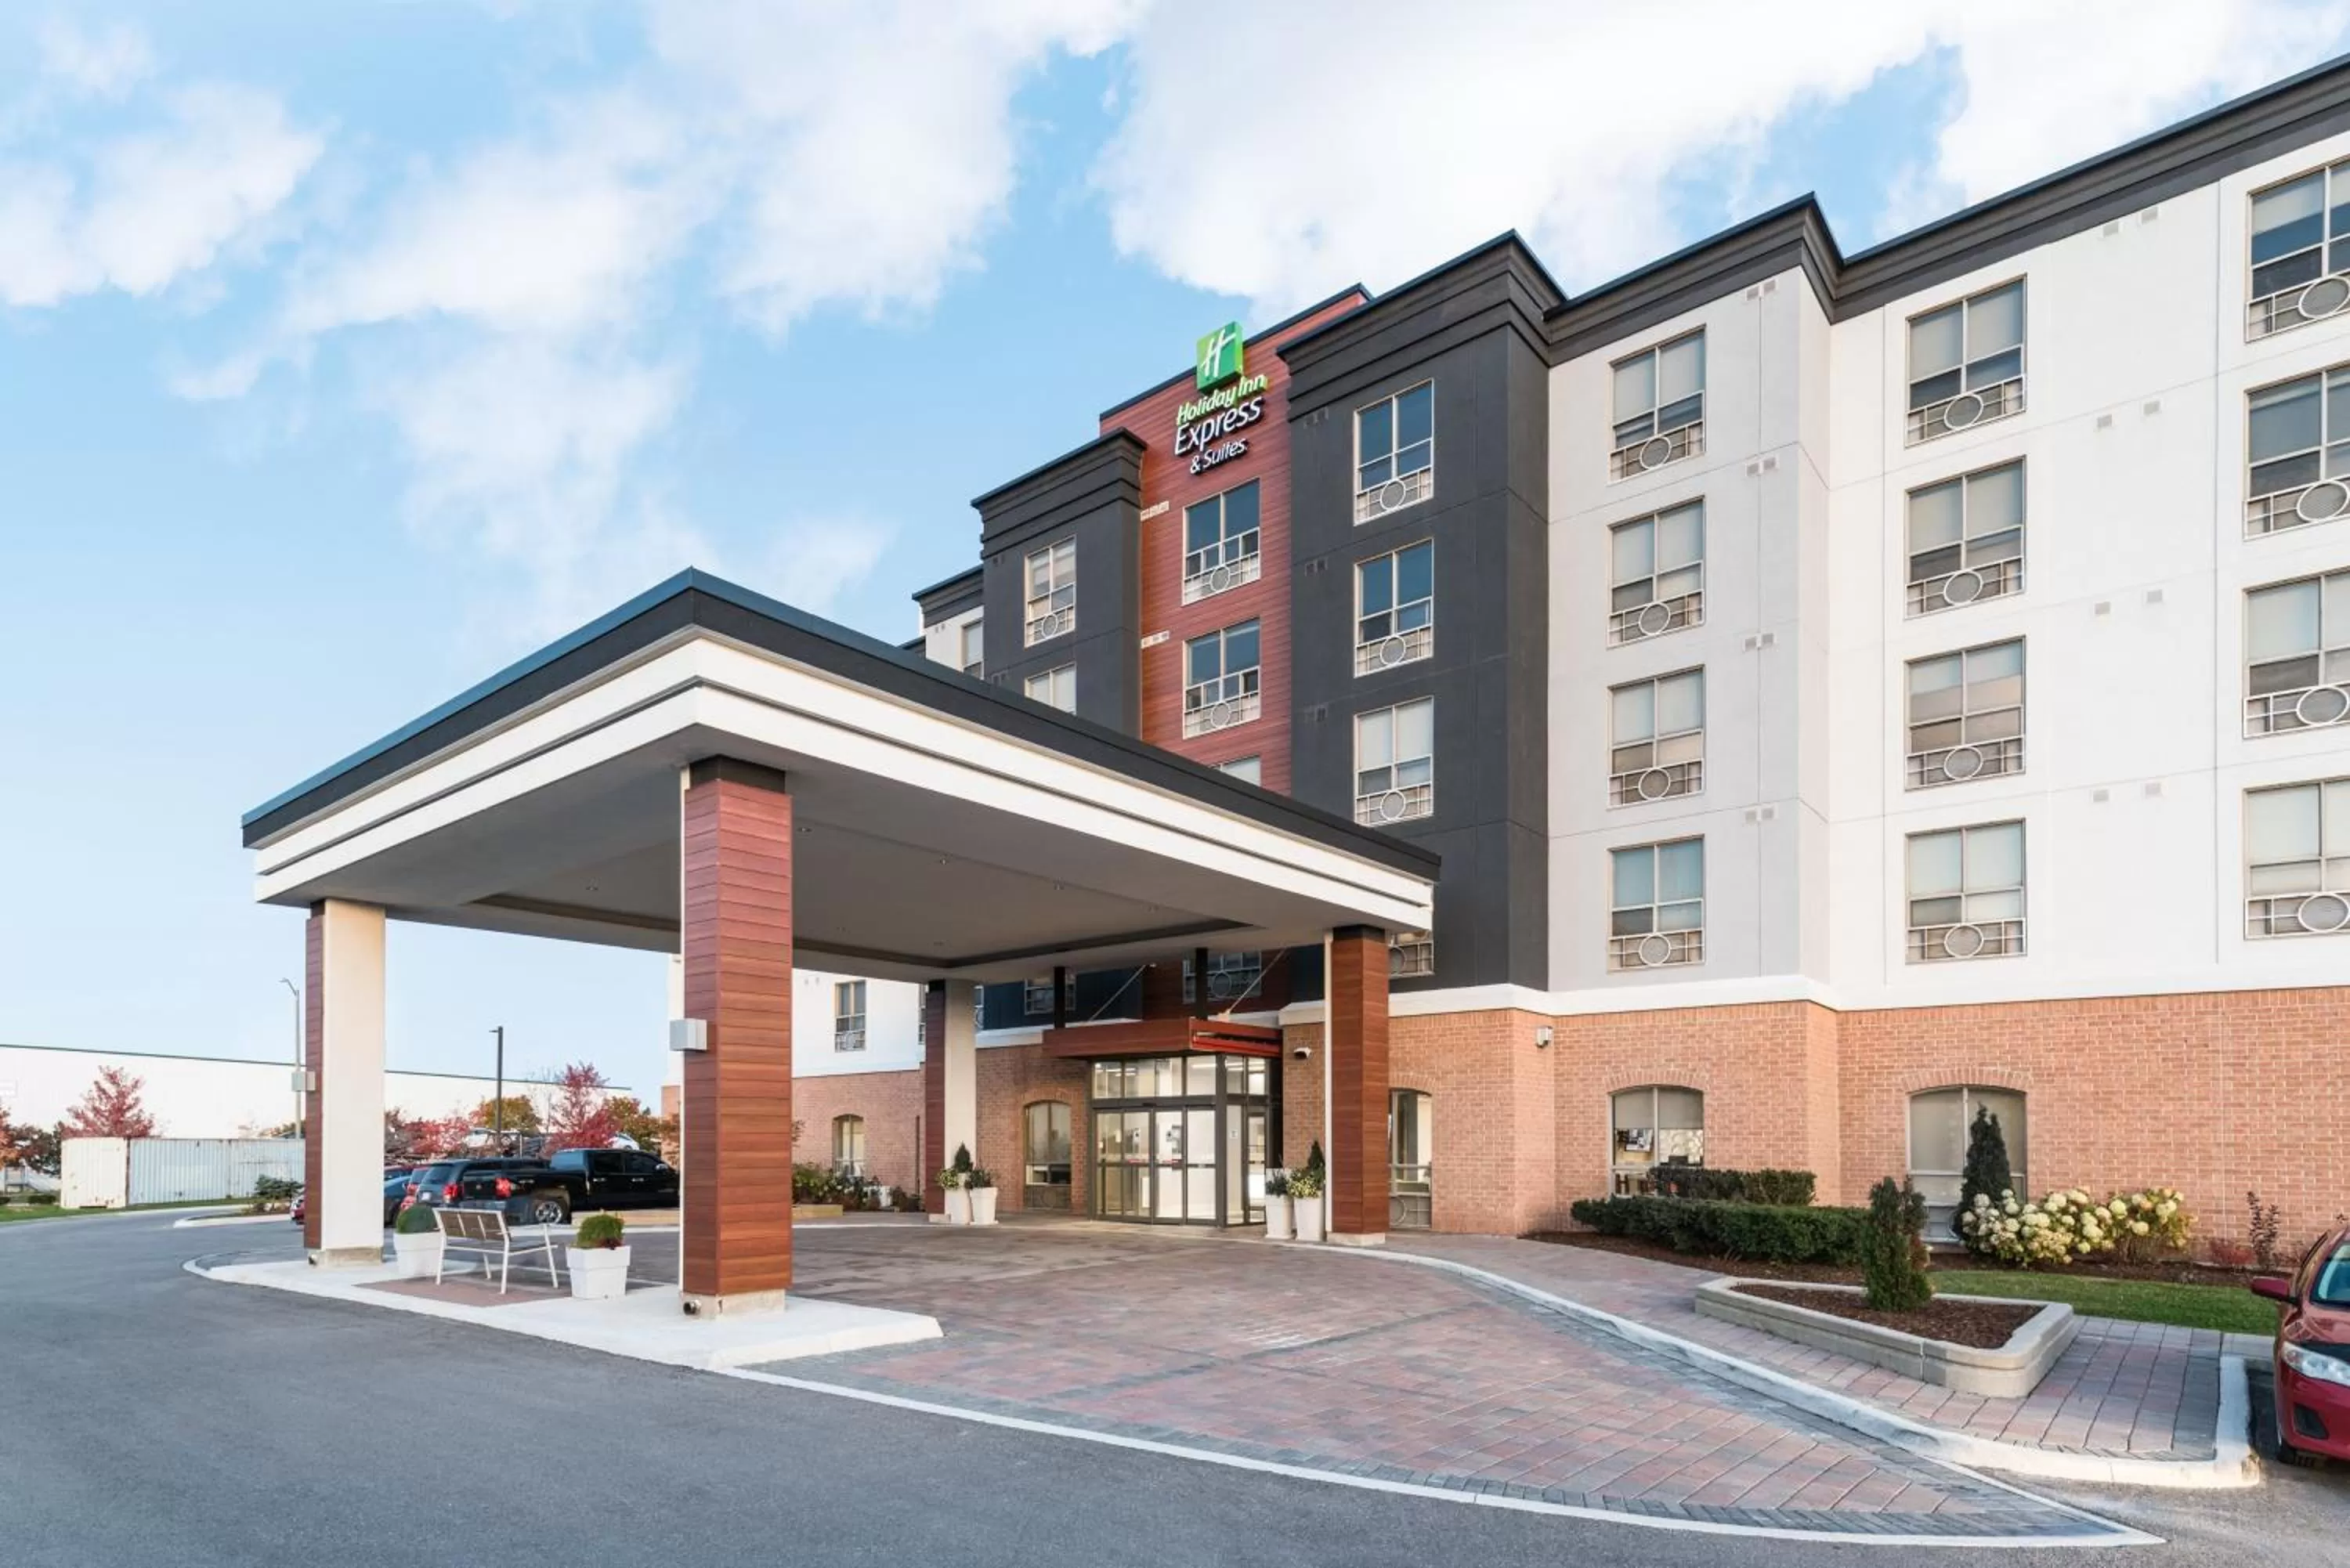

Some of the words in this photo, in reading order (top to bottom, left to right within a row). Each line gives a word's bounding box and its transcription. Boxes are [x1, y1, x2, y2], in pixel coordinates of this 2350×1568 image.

[1177, 385, 1238, 425] Holiday
[1238, 374, 1267, 397] Inn
[1175, 396, 1263, 455] Express
[1190, 455, 1202, 475] &
[1202, 438, 1247, 468] Suites
